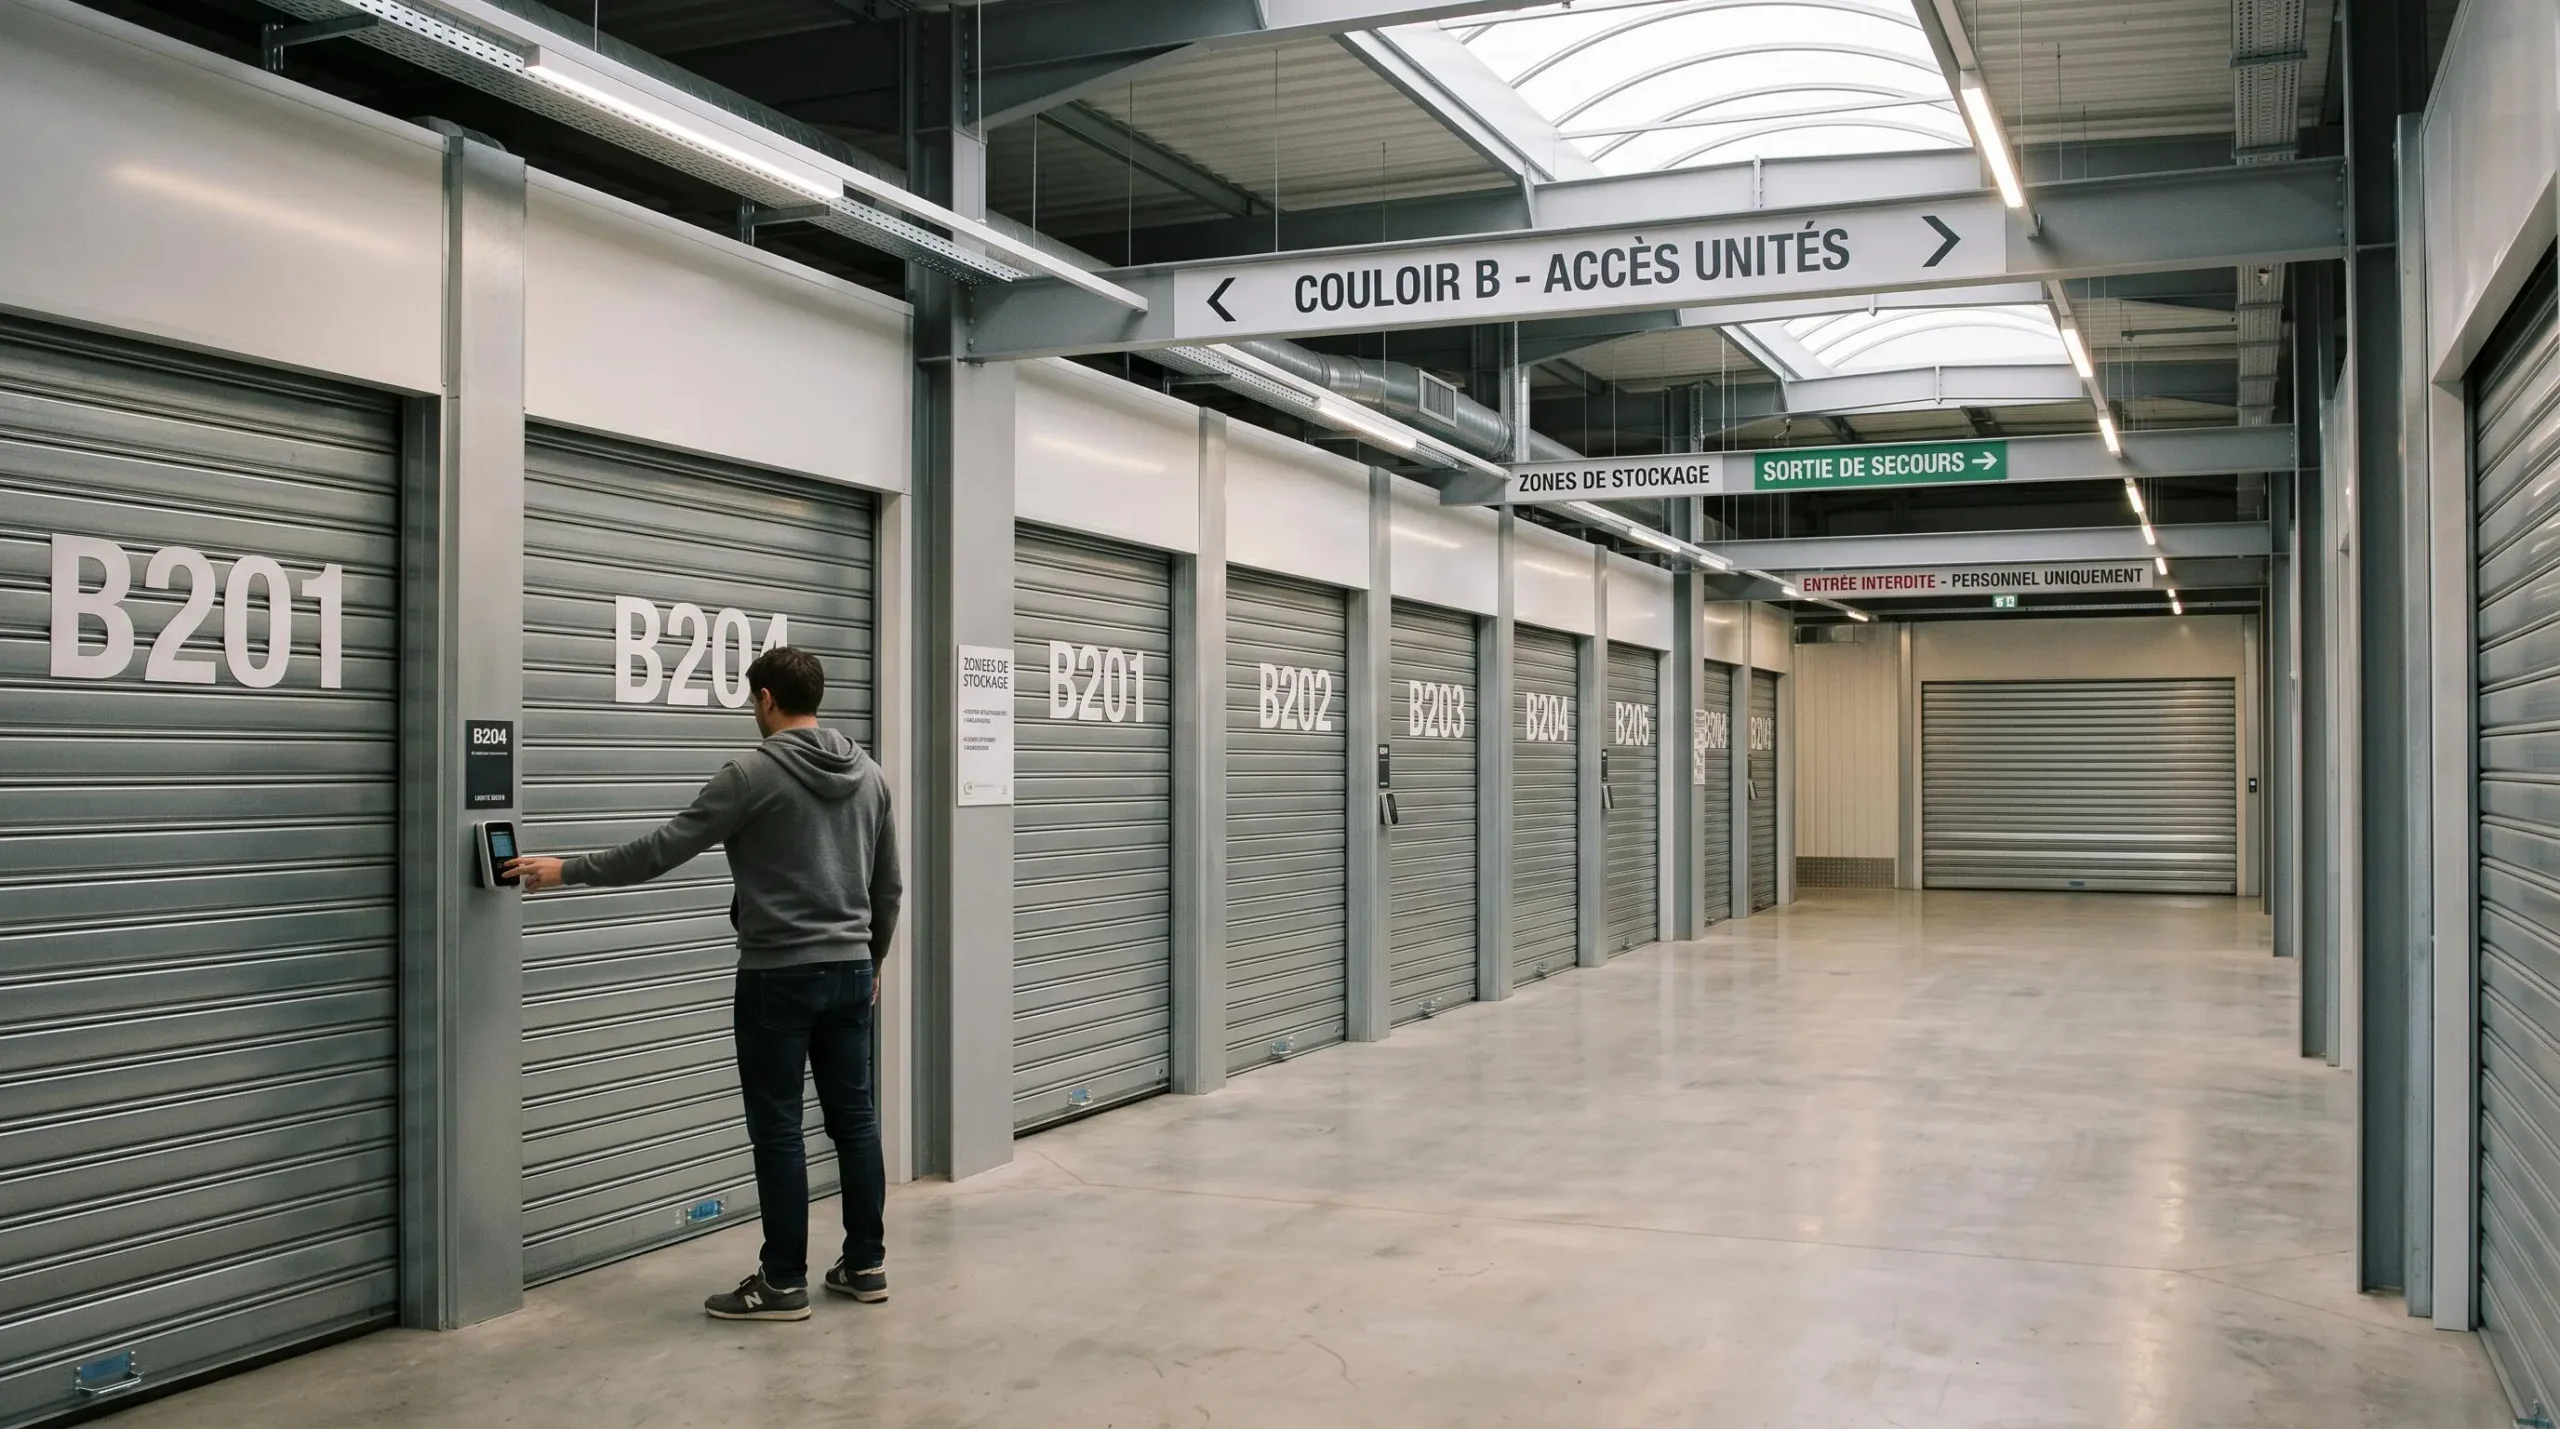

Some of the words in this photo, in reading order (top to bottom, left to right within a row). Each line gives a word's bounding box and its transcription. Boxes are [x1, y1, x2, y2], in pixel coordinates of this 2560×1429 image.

[1295, 262, 1460, 313] COULOIR
[1476, 259, 1500, 299] B
[1515, 274, 1530, 283] -
[1543, 236, 1680, 293] ACCÈS
[1695, 220, 1850, 281] UNITÉS
[1519, 472, 1577, 492] ZONES
[1583, 470, 1606, 489] DE
[1612, 465, 1710, 488] STOCKAGE
[1763, 458, 1833, 482] SORTIE
[1839, 457, 1865, 478] DE
[1871, 451, 1965, 476] SECOURS
[1803, 574, 1857, 592] ENTRÉE
[1861, 574, 1936, 590] INTERDITE
[1952, 571, 2040, 588] PERSONNEL
[2044, 568, 2144, 585] UNIQUEMENT
[50, 533, 342, 689] B201
[963, 673, 1009, 690] STOCKAGE
[997, 660, 1009, 674] DE
[1049, 640, 1144, 722] B201
[1260, 662, 1332, 732] B202
[1409, 680, 1465, 738] B203
[1526, 692, 1568, 741] B204
[1615, 701, 1650, 746] B205
[473, 727, 507, 745] B204
[744, 1291, 763, 1308] N
